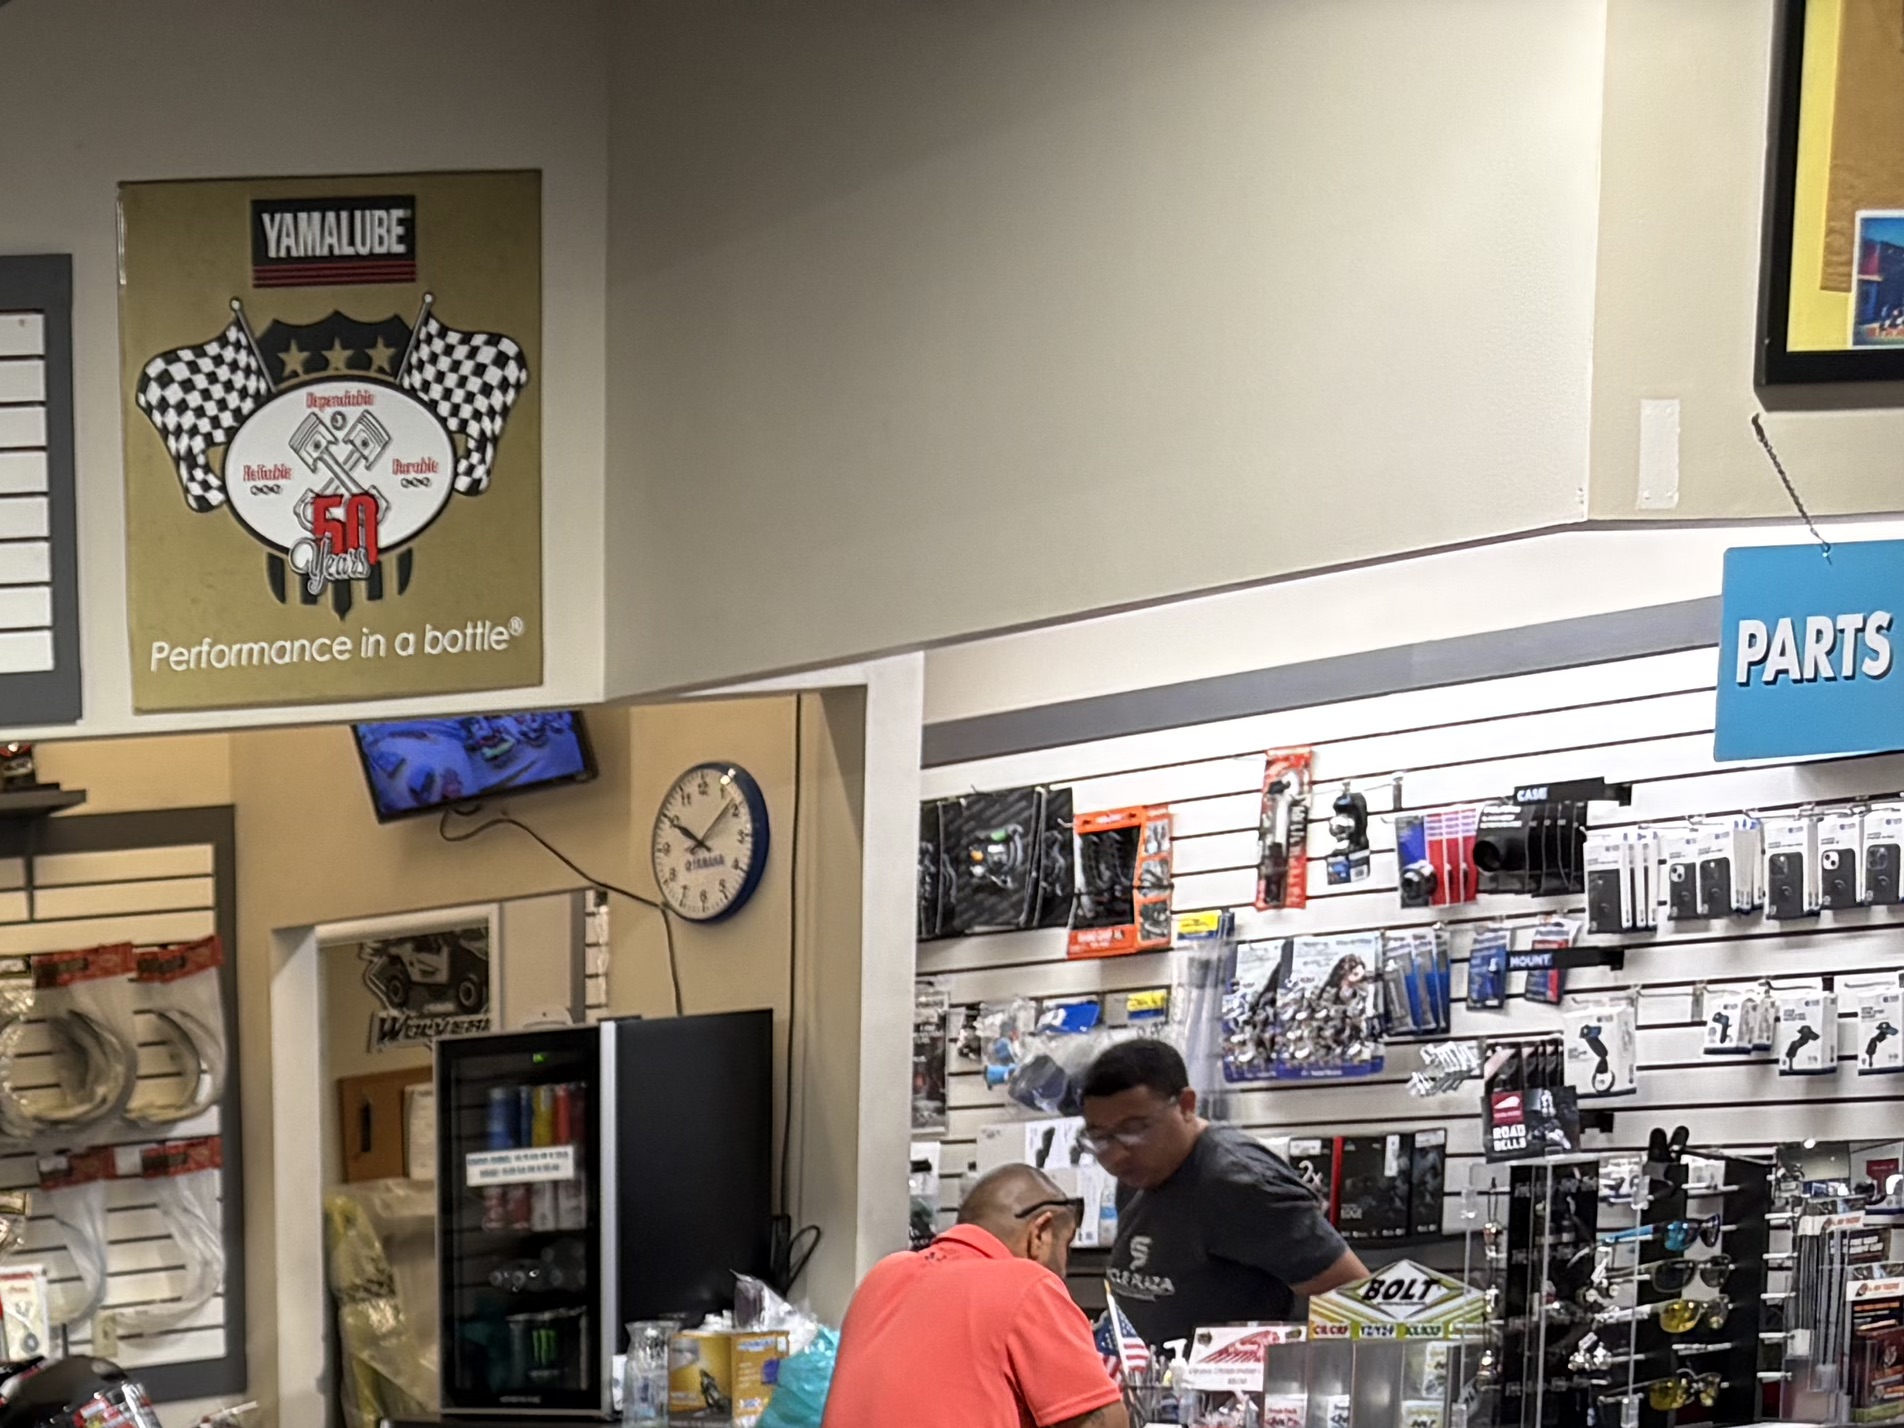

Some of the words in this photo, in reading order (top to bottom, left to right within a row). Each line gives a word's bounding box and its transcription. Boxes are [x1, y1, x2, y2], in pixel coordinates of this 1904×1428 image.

[262, 207, 408, 259] YAMALUBE
[312, 493, 380, 565] 50
[150, 634, 353, 672] Performance
[360, 627, 387, 659] in
[394, 633, 416, 657] a
[1735, 611, 1894, 686] PARTS
[1517, 787, 1548, 802] CASE
[1509, 954, 1552, 967] MOUNT
[1493, 1124, 1526, 1140] ROAD
[1362, 1278, 1441, 1301] BOLT
